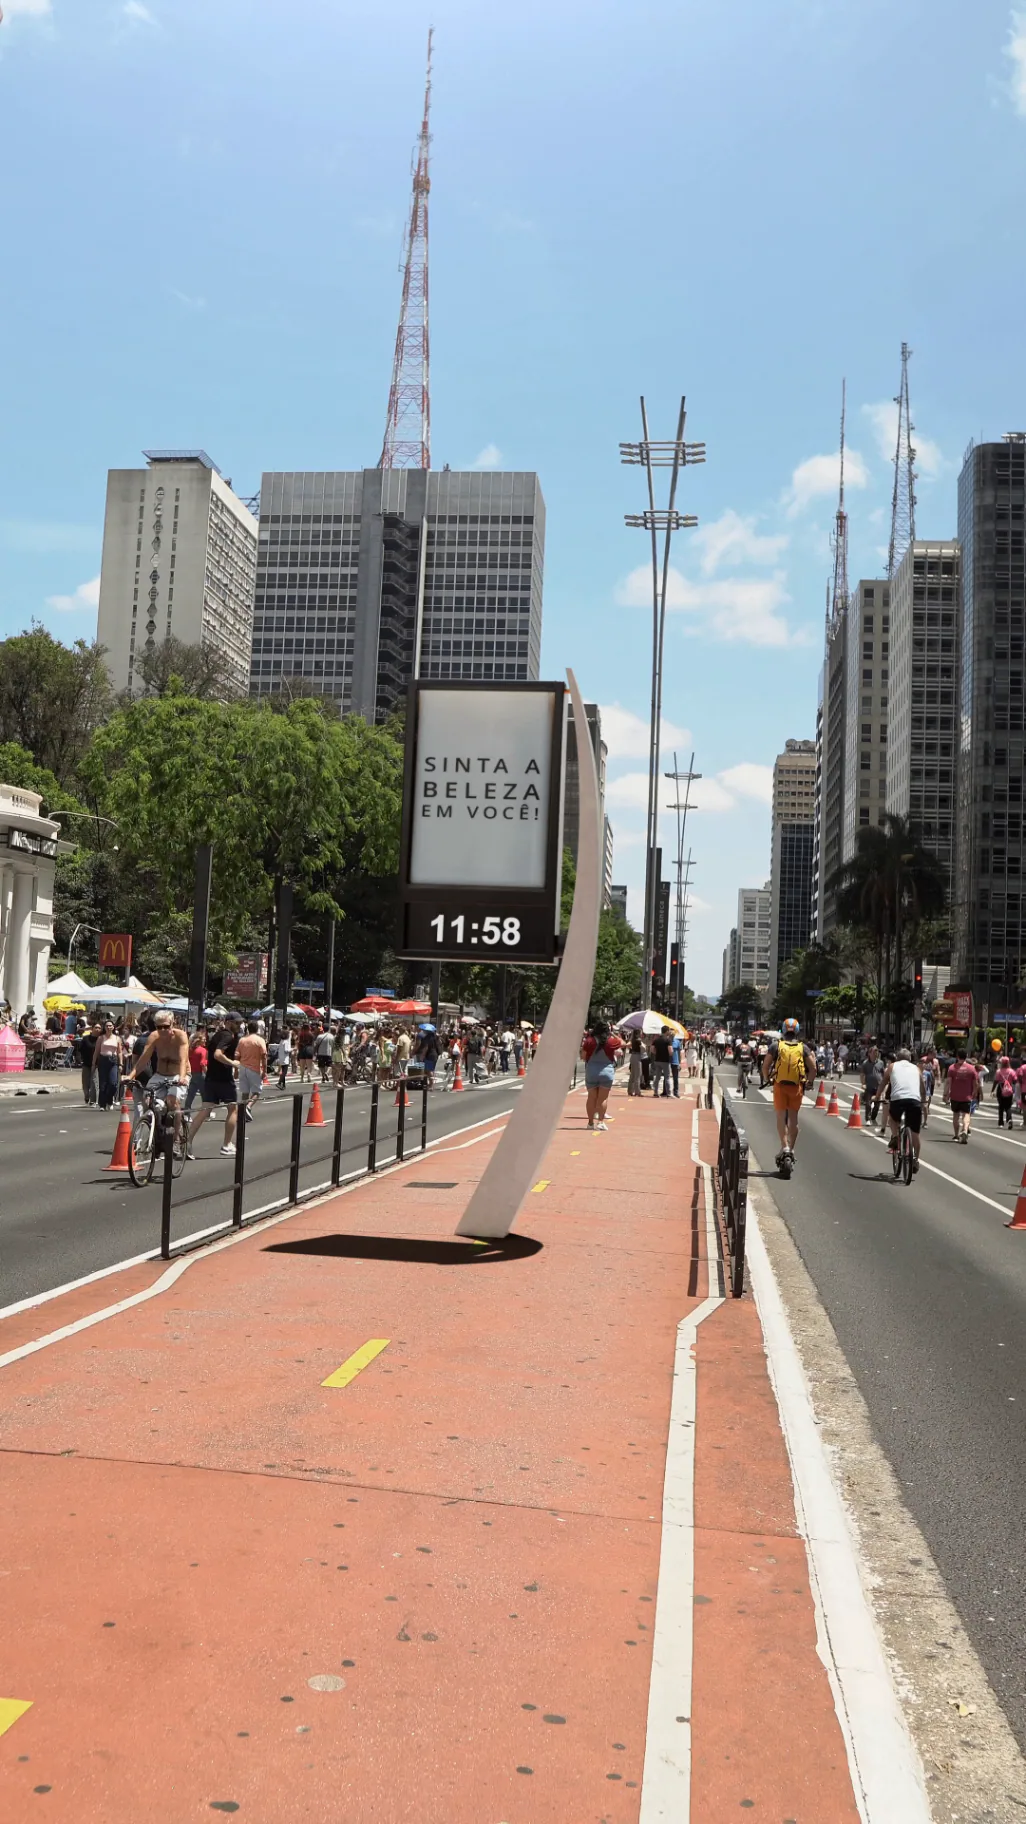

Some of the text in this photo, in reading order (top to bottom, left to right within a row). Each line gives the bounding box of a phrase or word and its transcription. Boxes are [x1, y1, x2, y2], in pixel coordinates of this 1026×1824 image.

[424, 757, 540, 774] SINTA A
[423, 781, 540, 800] BELEZA
[421, 804, 539, 820] EM VOCÊ!
[430, 915, 521, 946] 11:58
